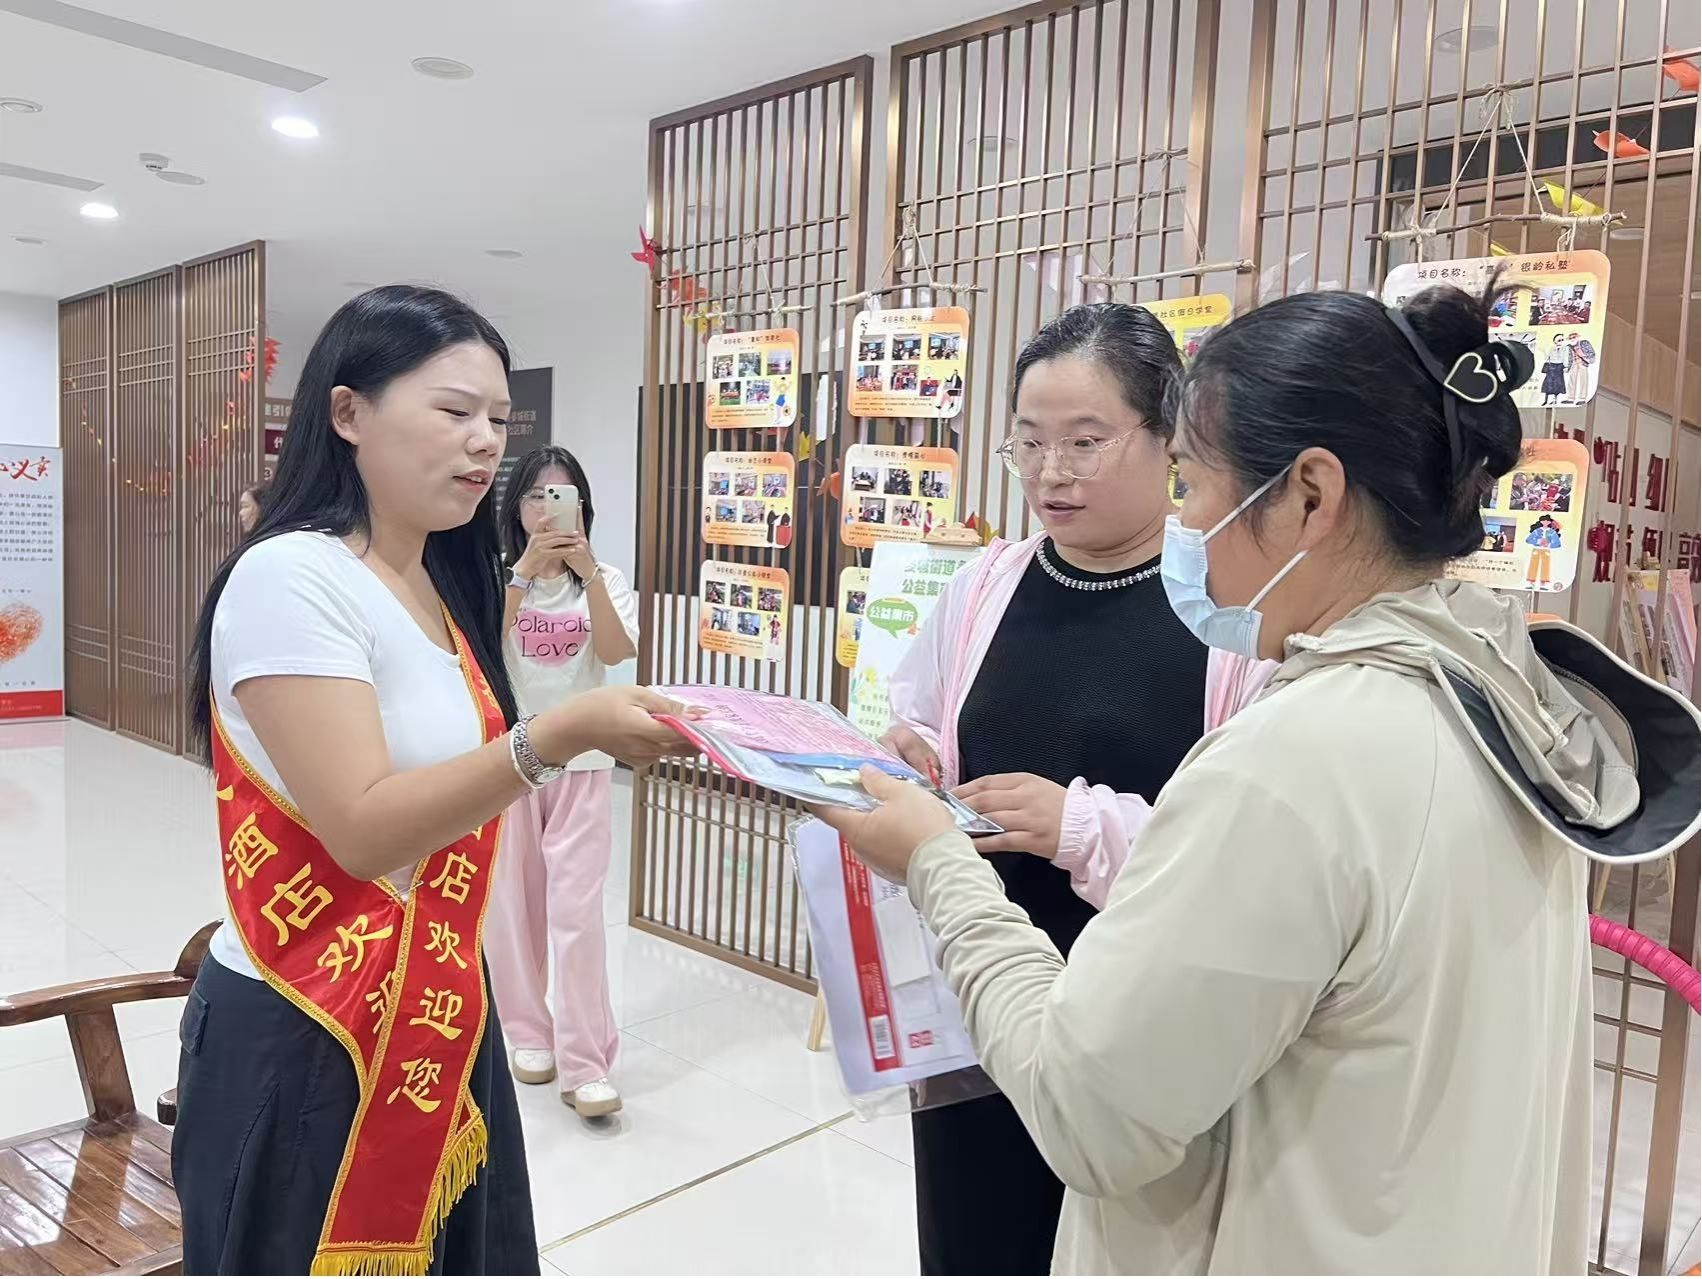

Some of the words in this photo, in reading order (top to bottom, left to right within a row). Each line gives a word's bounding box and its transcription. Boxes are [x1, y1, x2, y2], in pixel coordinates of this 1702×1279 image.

[902, 578, 946, 596] 公益集
[521, 635, 579, 658] Love
